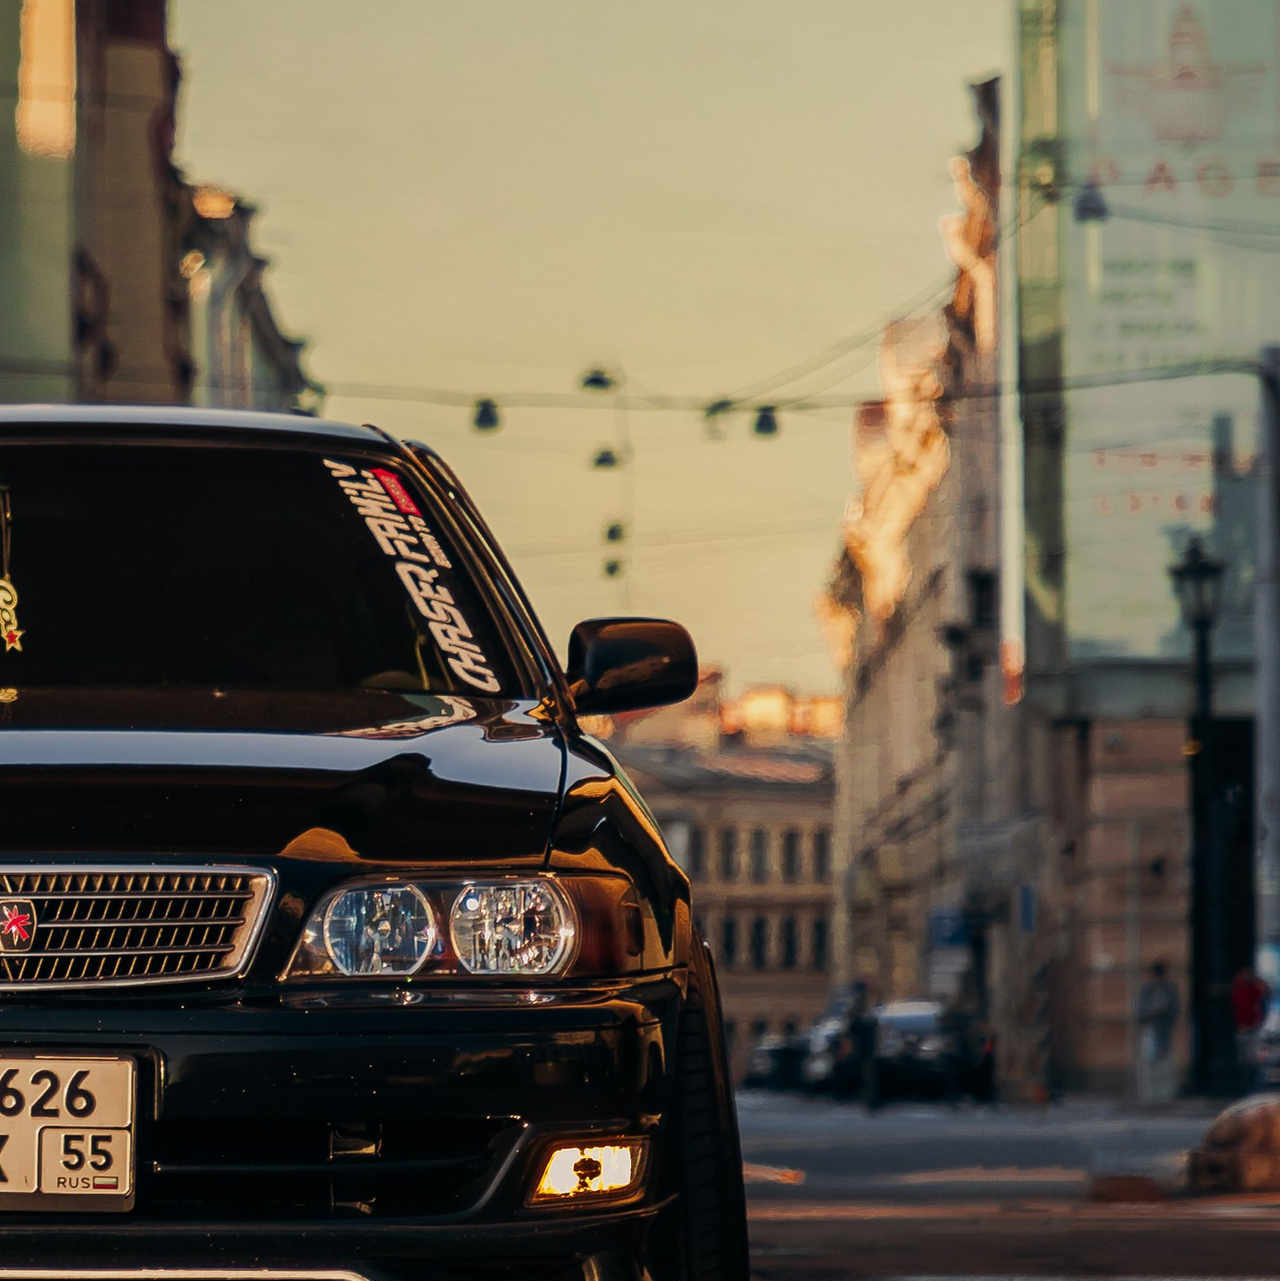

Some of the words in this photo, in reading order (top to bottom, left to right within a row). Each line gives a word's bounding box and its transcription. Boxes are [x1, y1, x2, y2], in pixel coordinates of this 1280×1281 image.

[322, 458, 431, 564] FAMILY
[394, 561, 501, 693] CHASER
[56, 1175, 91, 1189] RUS
[60, 1133, 114, 1172] 55
